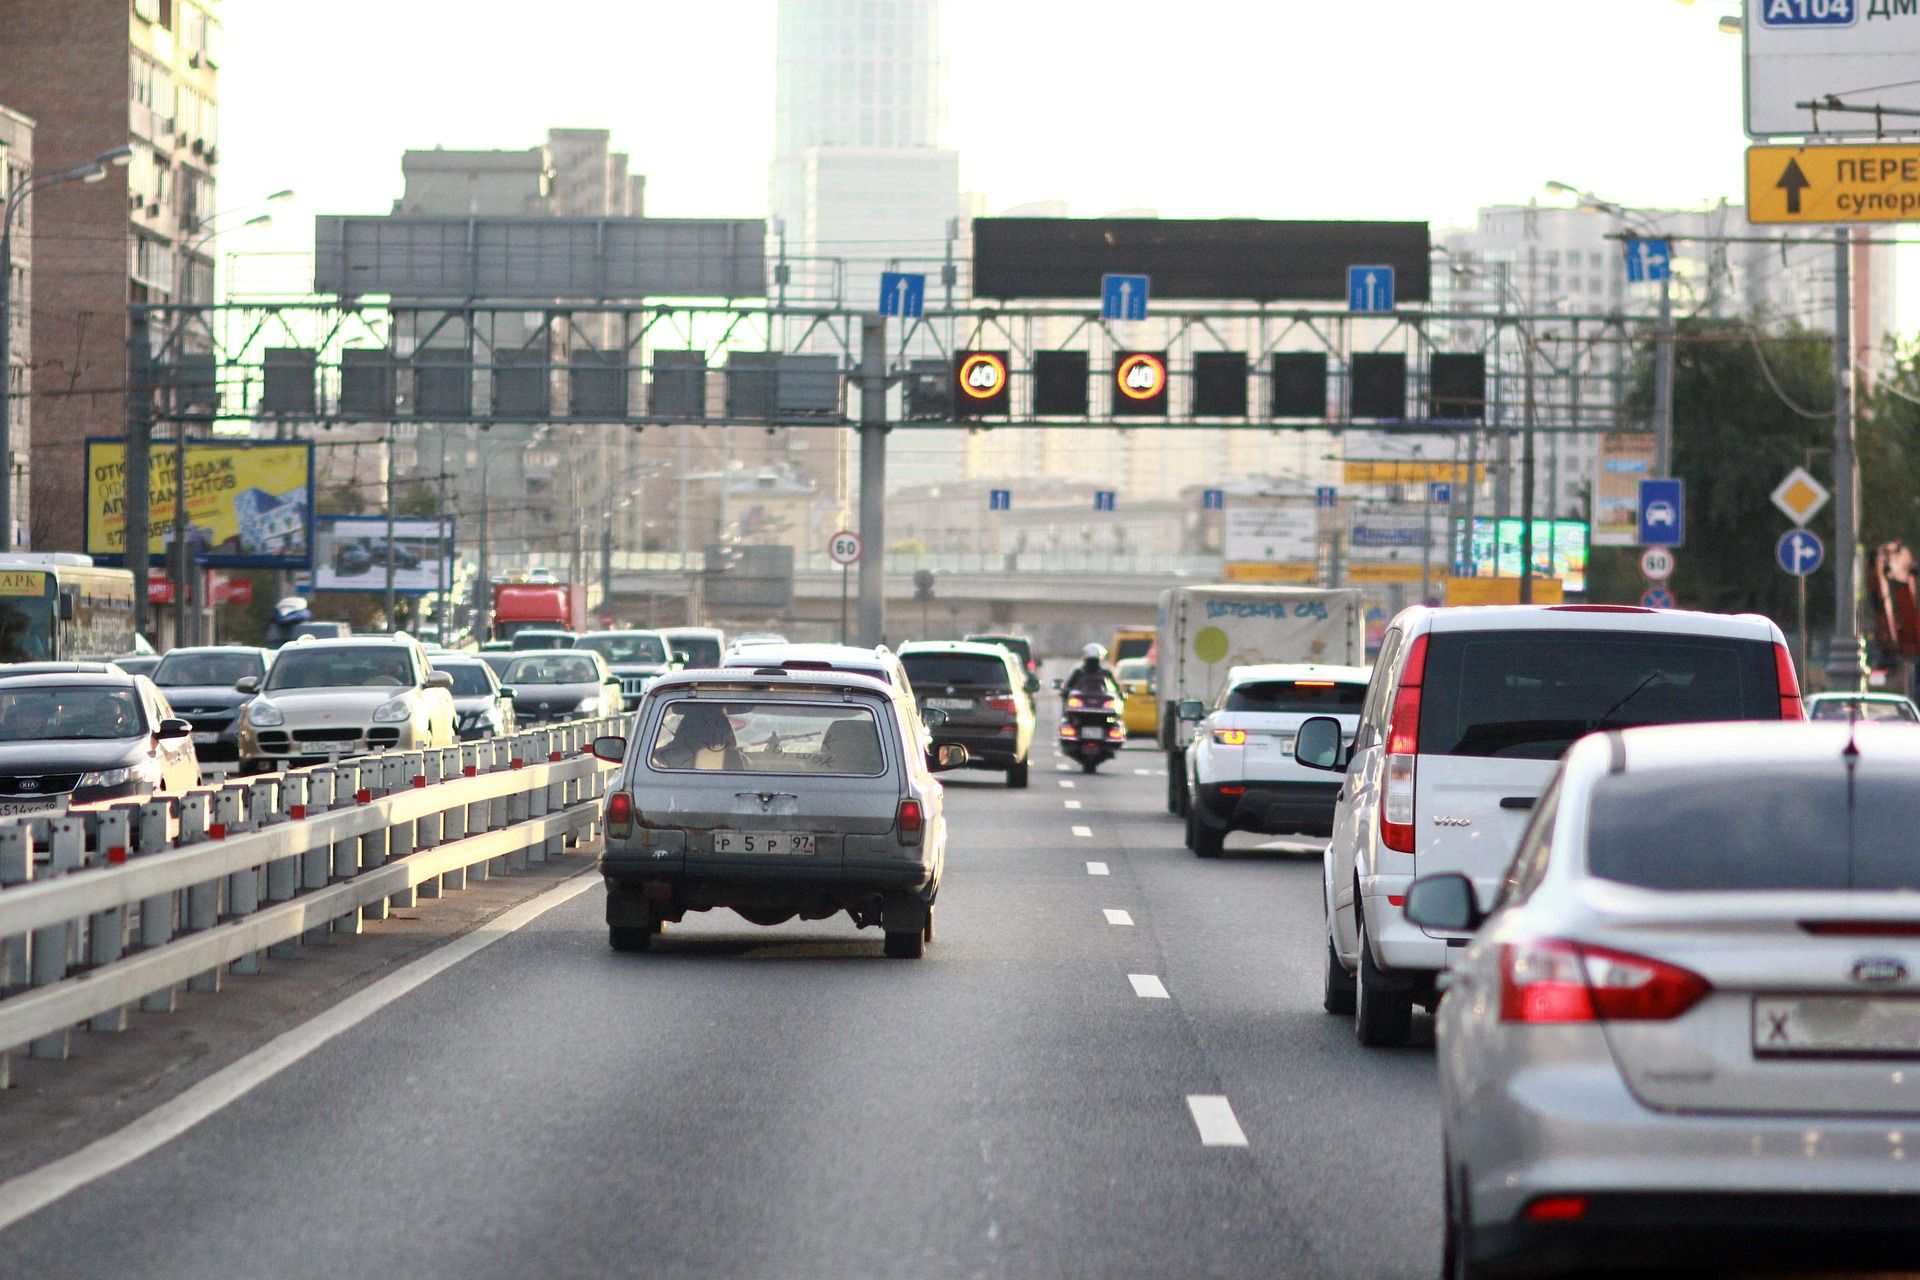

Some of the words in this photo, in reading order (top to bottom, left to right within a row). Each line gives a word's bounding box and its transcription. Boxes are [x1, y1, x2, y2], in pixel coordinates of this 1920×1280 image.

[1768, 0, 1849, 19] A104
[1836, 193, 1920, 216] супер
[836, 541, 855, 555] 60
